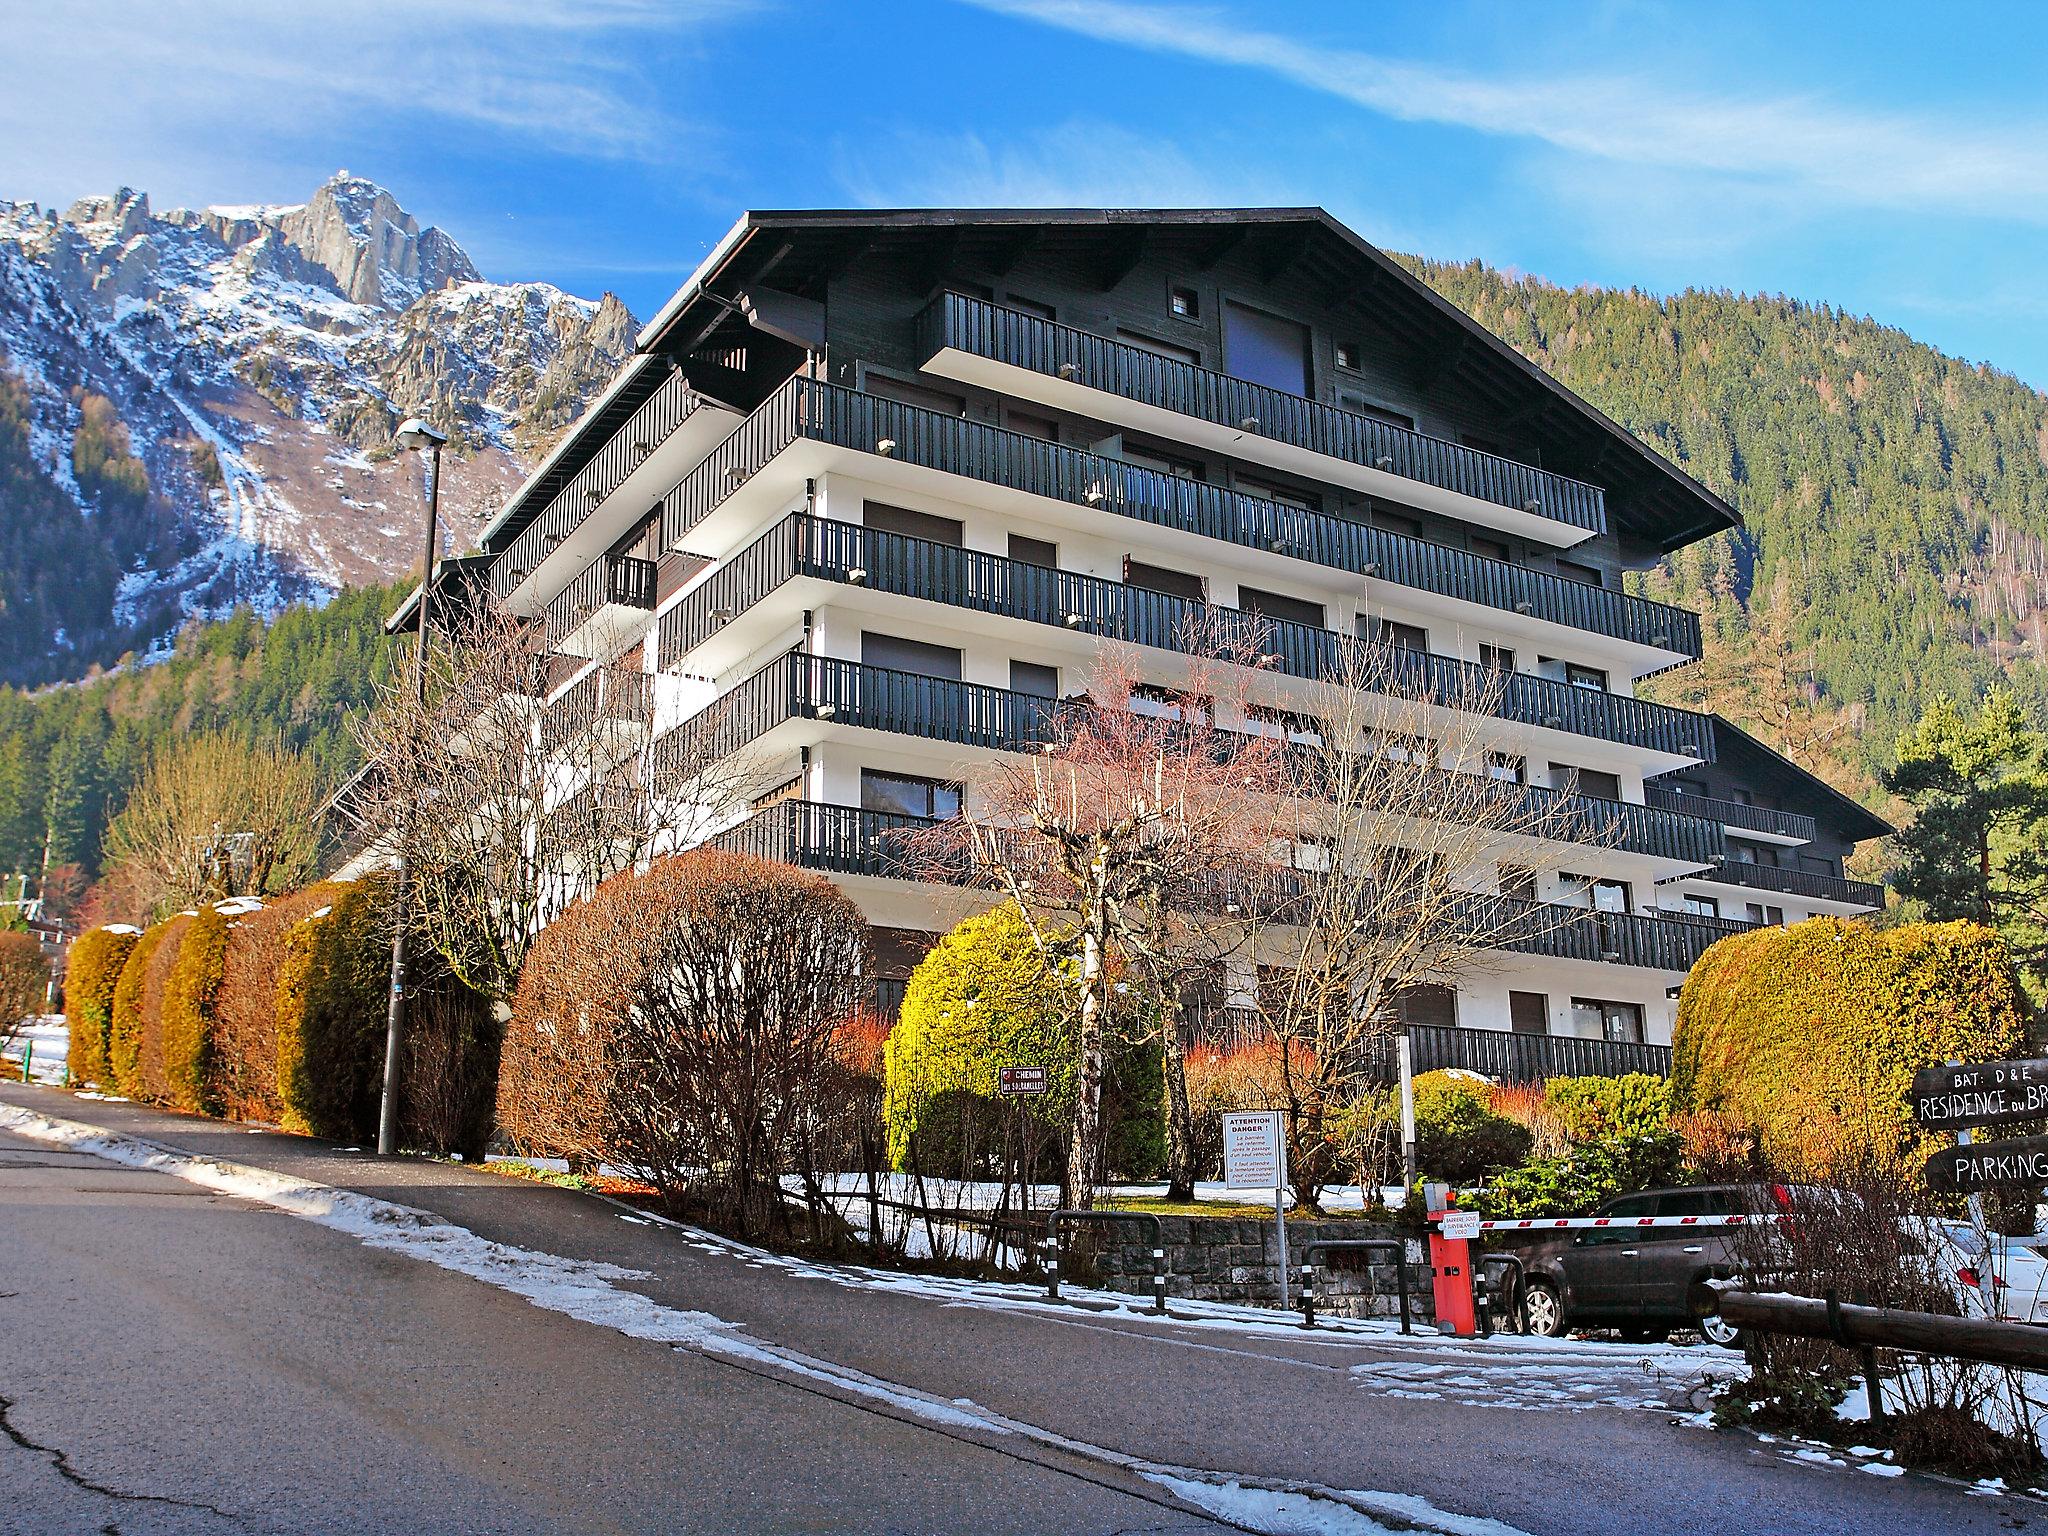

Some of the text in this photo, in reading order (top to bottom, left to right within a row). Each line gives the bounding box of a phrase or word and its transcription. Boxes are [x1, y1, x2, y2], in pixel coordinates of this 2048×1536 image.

[1016, 1070, 1042, 1079] CHEMIN
[1954, 1067, 2031, 1088] BAT: D & E
[1955, 1153, 2048, 1182] PARKING
